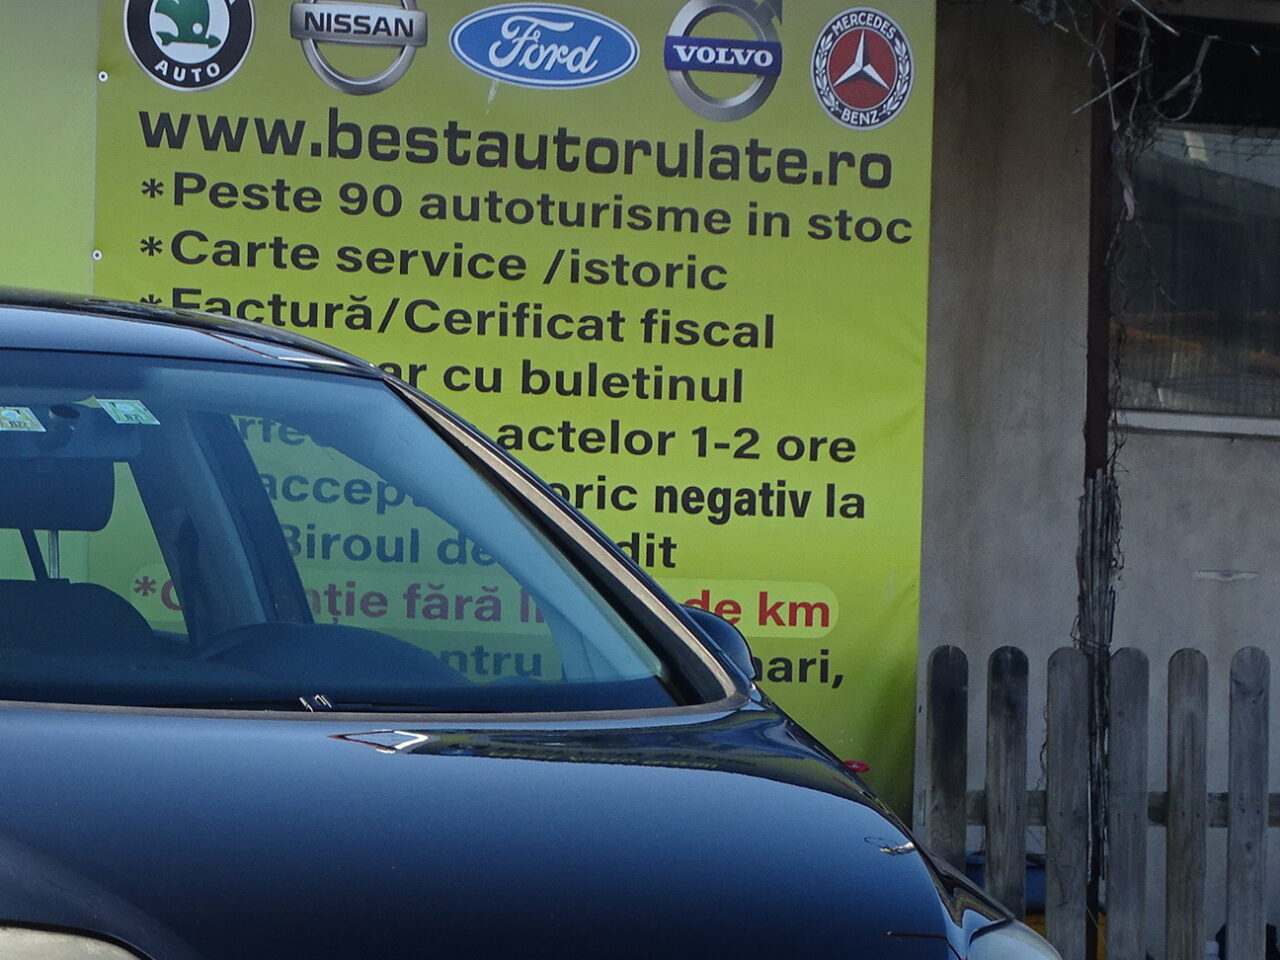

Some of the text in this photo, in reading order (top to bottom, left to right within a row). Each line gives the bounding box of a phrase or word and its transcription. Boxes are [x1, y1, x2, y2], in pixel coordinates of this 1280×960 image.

[304, 11, 414, 38] NISSAN
[488, 15, 602, 74] Ford
[831, 12, 897, 40] MERCEDES
[154, 59, 221, 83] AUTO
[673, 45, 774, 68] VOLVO
[841, 109, 880, 126] BENZ
[138, 106, 892, 189] www.bestautorulate.ro
[338, 182, 402, 217] 90
[420, 190, 731, 235] autoturisme
[748, 202, 790, 238] in
[808, 209, 912, 244] stoc
[336, 242, 526, 281] service
[542, 248, 728, 291] /istoric
[641, 308, 774, 349] fiscal
[443, 366, 502, 394] cu
[521, 359, 743, 404] buletinul
[496, 419, 676, 456] actelor
[691, 426, 761, 460] 1-2
[776, 434, 856, 463] ore
[654, 480, 812, 526] negativ
[826, 483, 866, 519] la
[403, 583, 502, 622] fără
[758, 591, 830, 628] km
